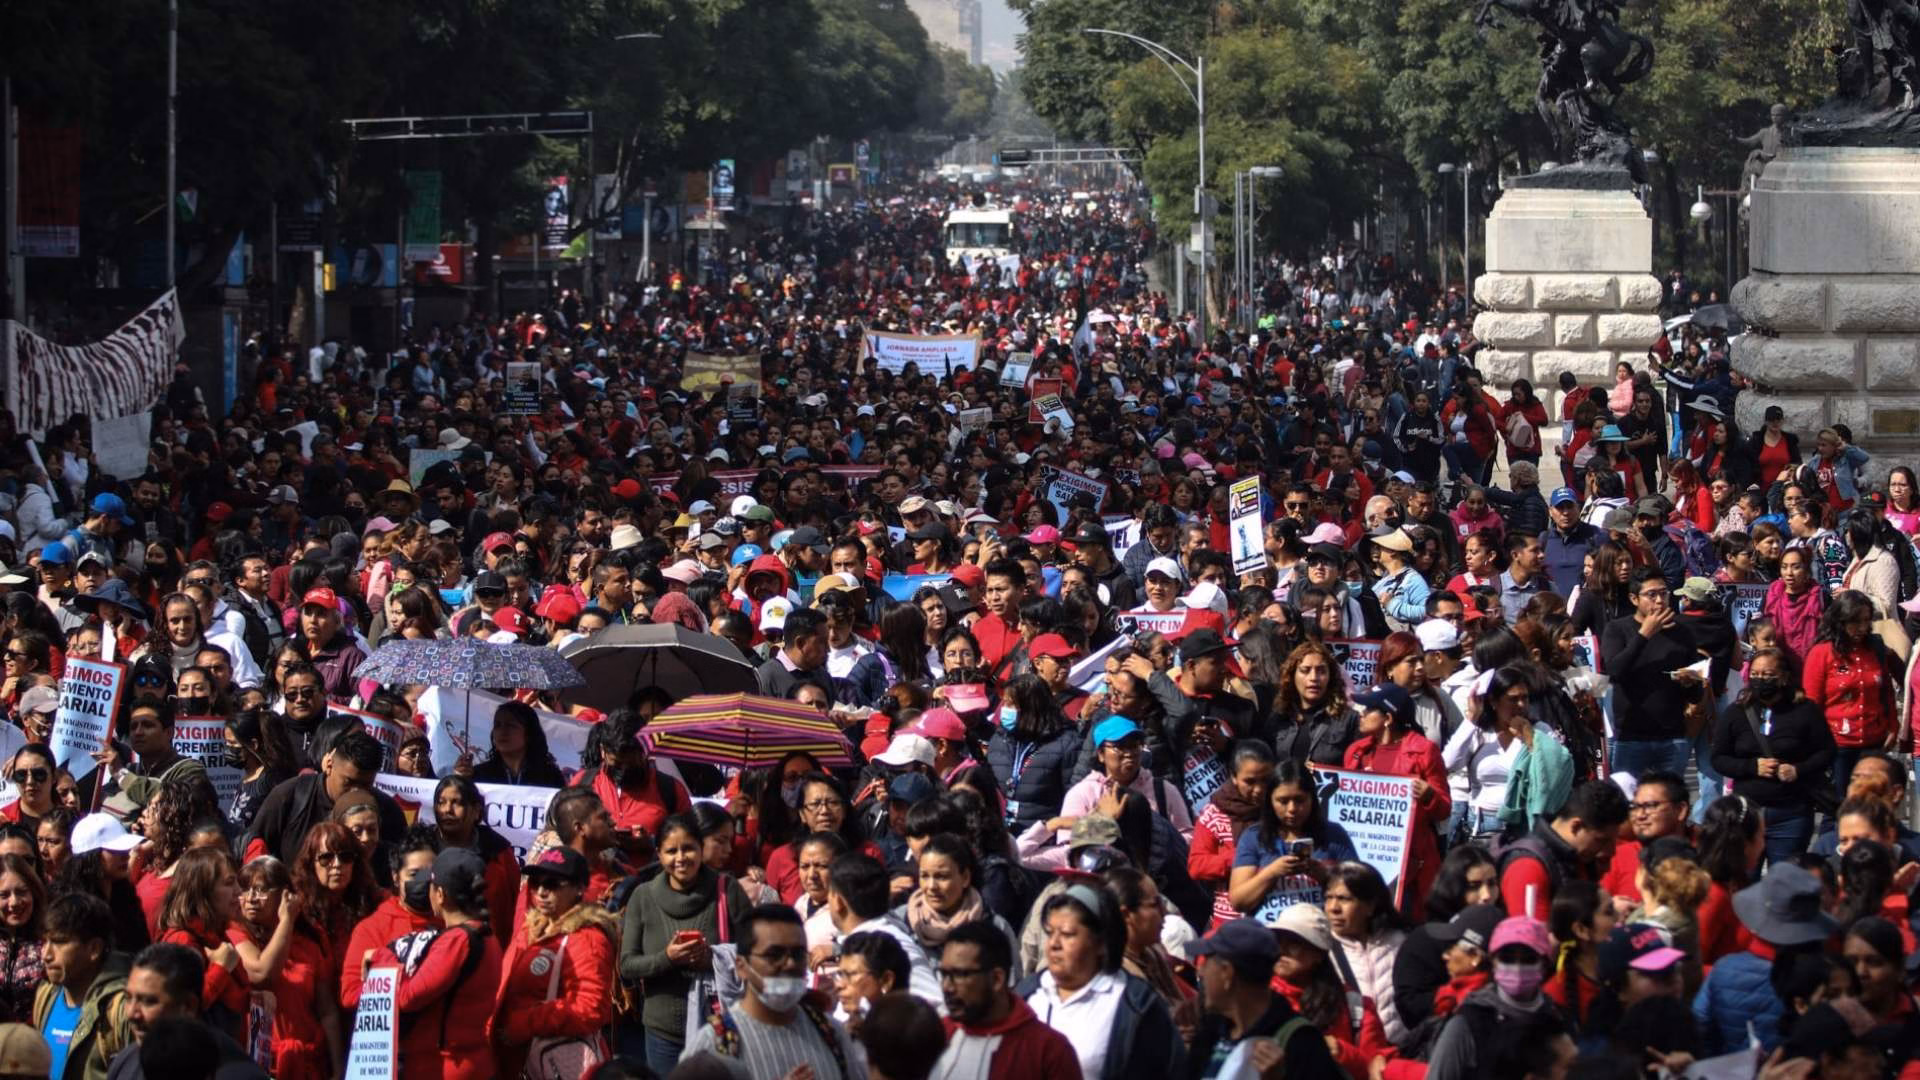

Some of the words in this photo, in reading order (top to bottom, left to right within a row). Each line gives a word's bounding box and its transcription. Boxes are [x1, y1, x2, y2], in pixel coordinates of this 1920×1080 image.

[1339, 778, 1408, 798] EXIGIMOS
[1333, 793, 1408, 812] INCREMENTO
[1338, 808, 1405, 828] SALARIAL
